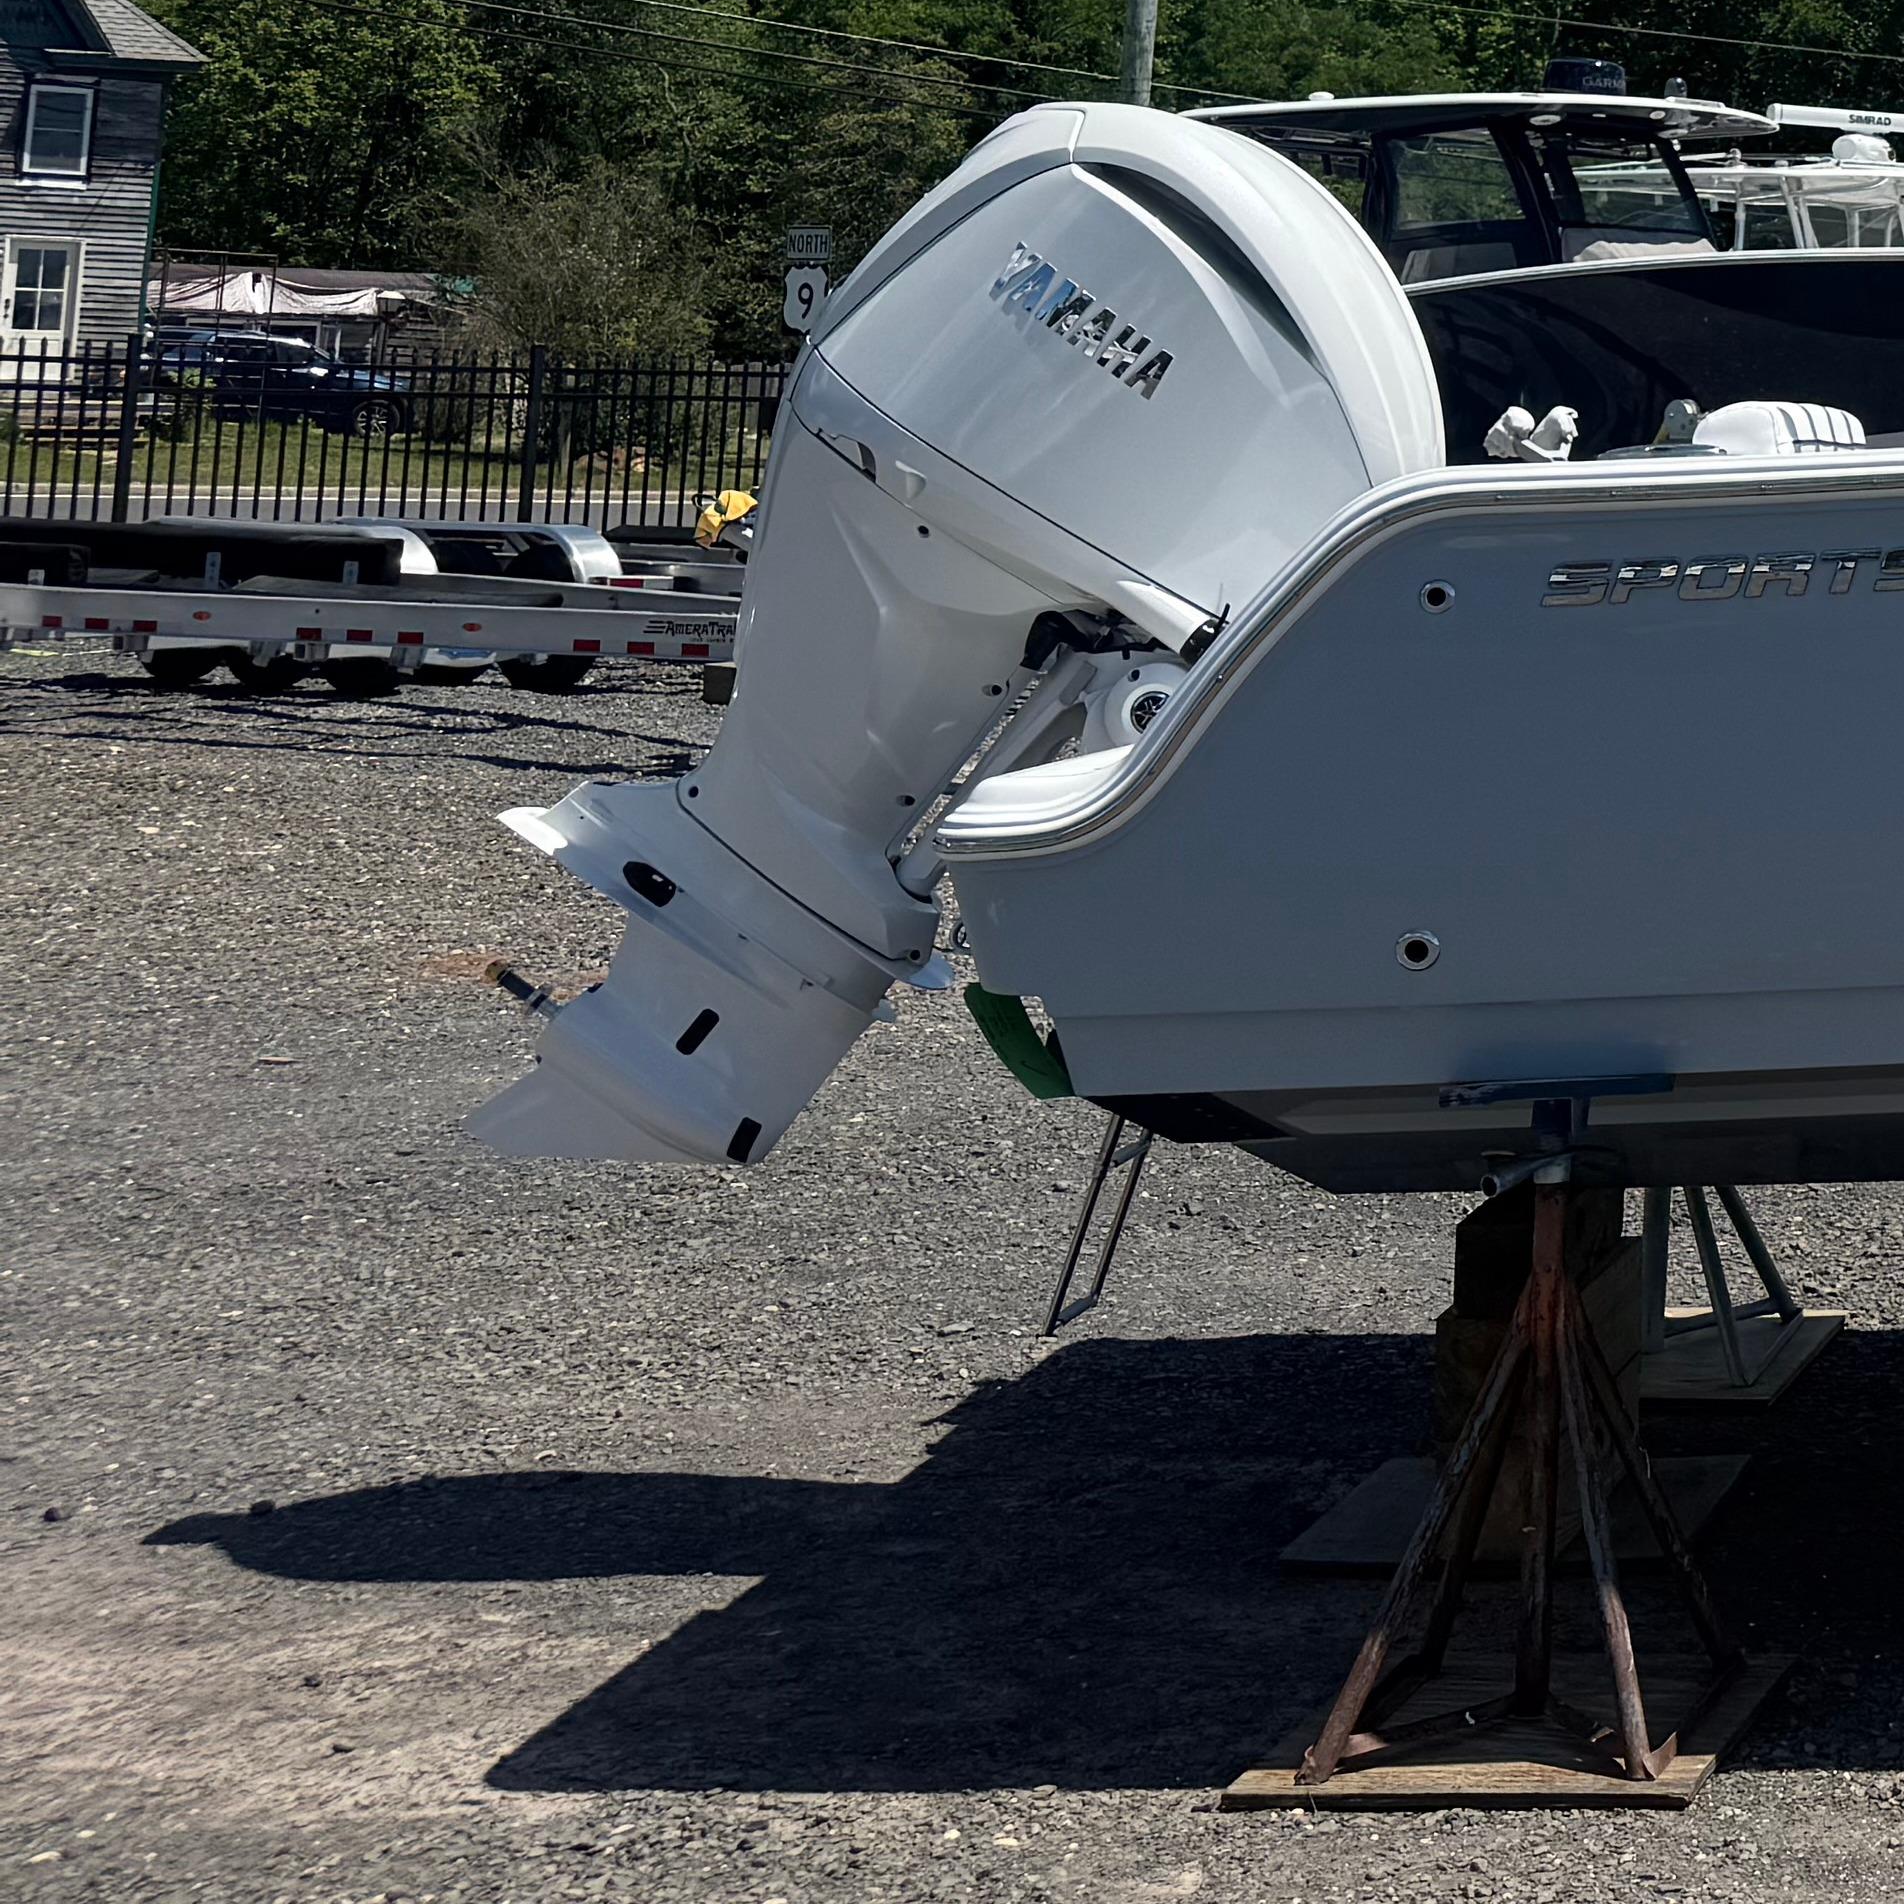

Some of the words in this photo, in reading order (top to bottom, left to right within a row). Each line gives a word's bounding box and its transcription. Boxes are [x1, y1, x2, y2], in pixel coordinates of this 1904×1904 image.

[1848, 114, 1892, 126] SIMRAD
[789, 234, 828, 253] NORTH
[797, 282, 814, 320] 9
[989, 241, 1175, 401] YAMAHA
